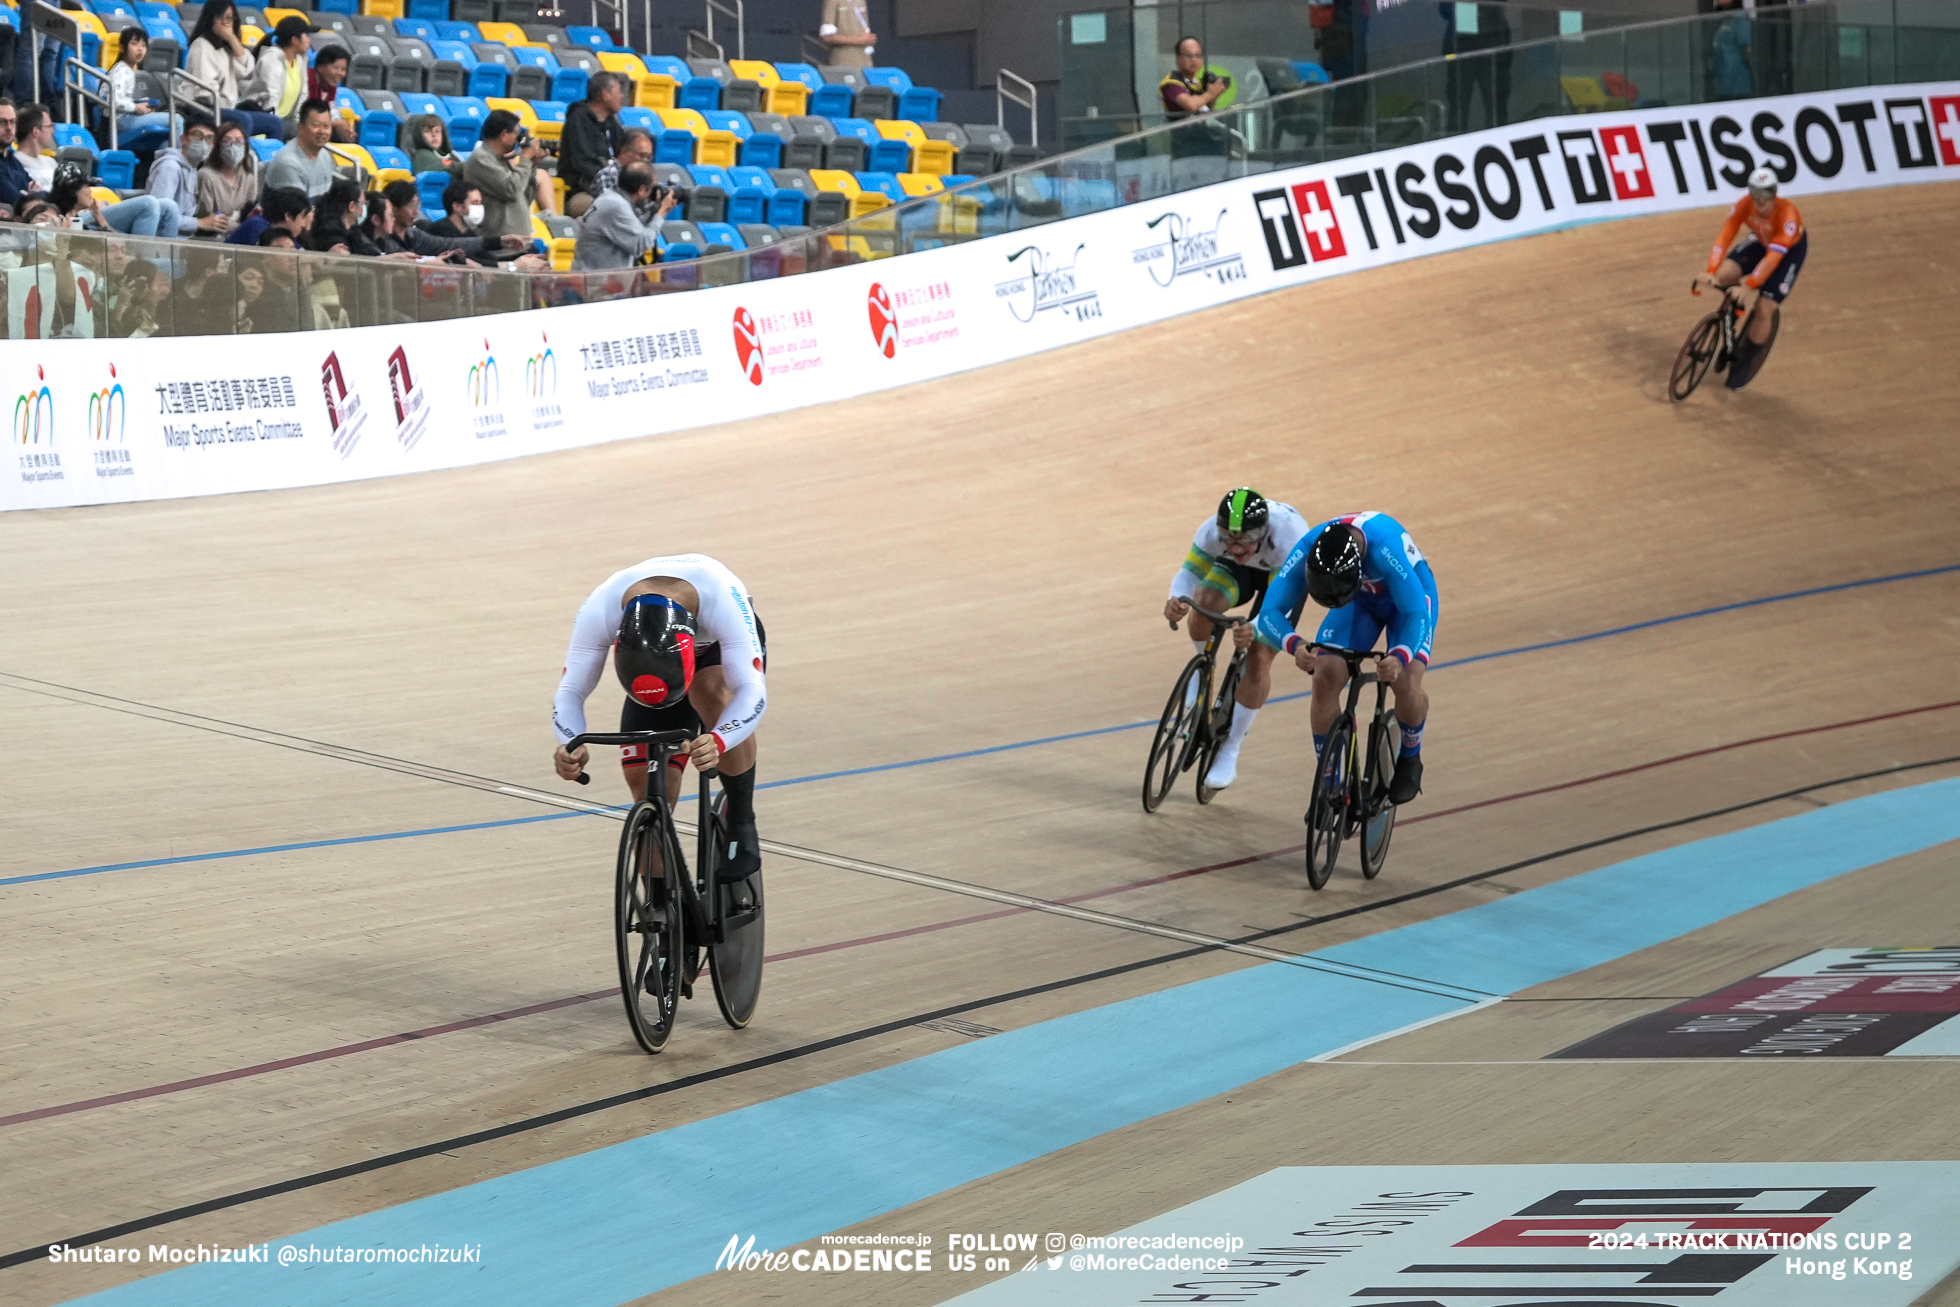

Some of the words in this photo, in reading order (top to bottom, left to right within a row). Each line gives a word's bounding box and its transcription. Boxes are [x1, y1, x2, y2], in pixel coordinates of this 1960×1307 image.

[1647, 100, 1877, 195] TISSOT
[1335, 134, 1555, 250] TISSOT
[155, 376, 296, 415] 大型體育活動事務委員會
[163, 424, 191, 451] Major
[192, 423, 226, 451] Sports
[226, 421, 256, 443] Events
[256, 417, 303, 440] Committee
[1292, 1191, 1474, 1237] SWISS
